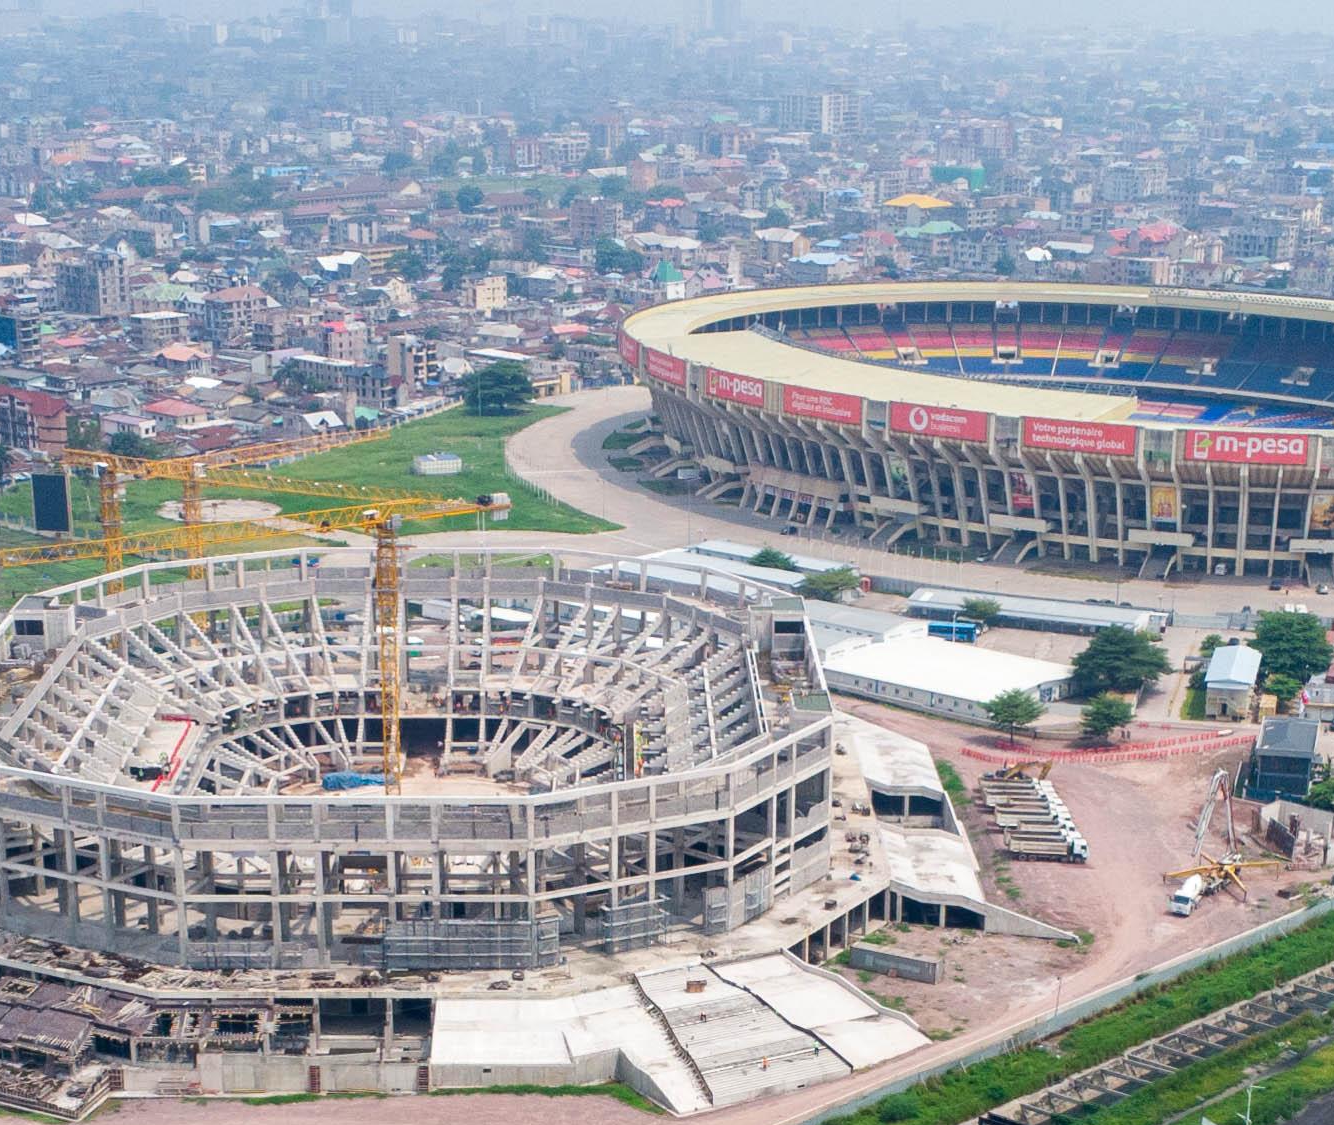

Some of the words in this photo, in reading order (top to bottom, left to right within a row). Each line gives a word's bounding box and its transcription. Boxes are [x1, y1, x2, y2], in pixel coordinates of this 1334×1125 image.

[719, 375, 763, 398] m-pesa
[1033, 422, 1057, 432] Votre
[1057, 425, 1103, 437] partenaire
[1032, 433, 1096, 448] technologique
[1096, 440, 1125, 450] global
[1215, 435, 1304, 458] m-pesa
